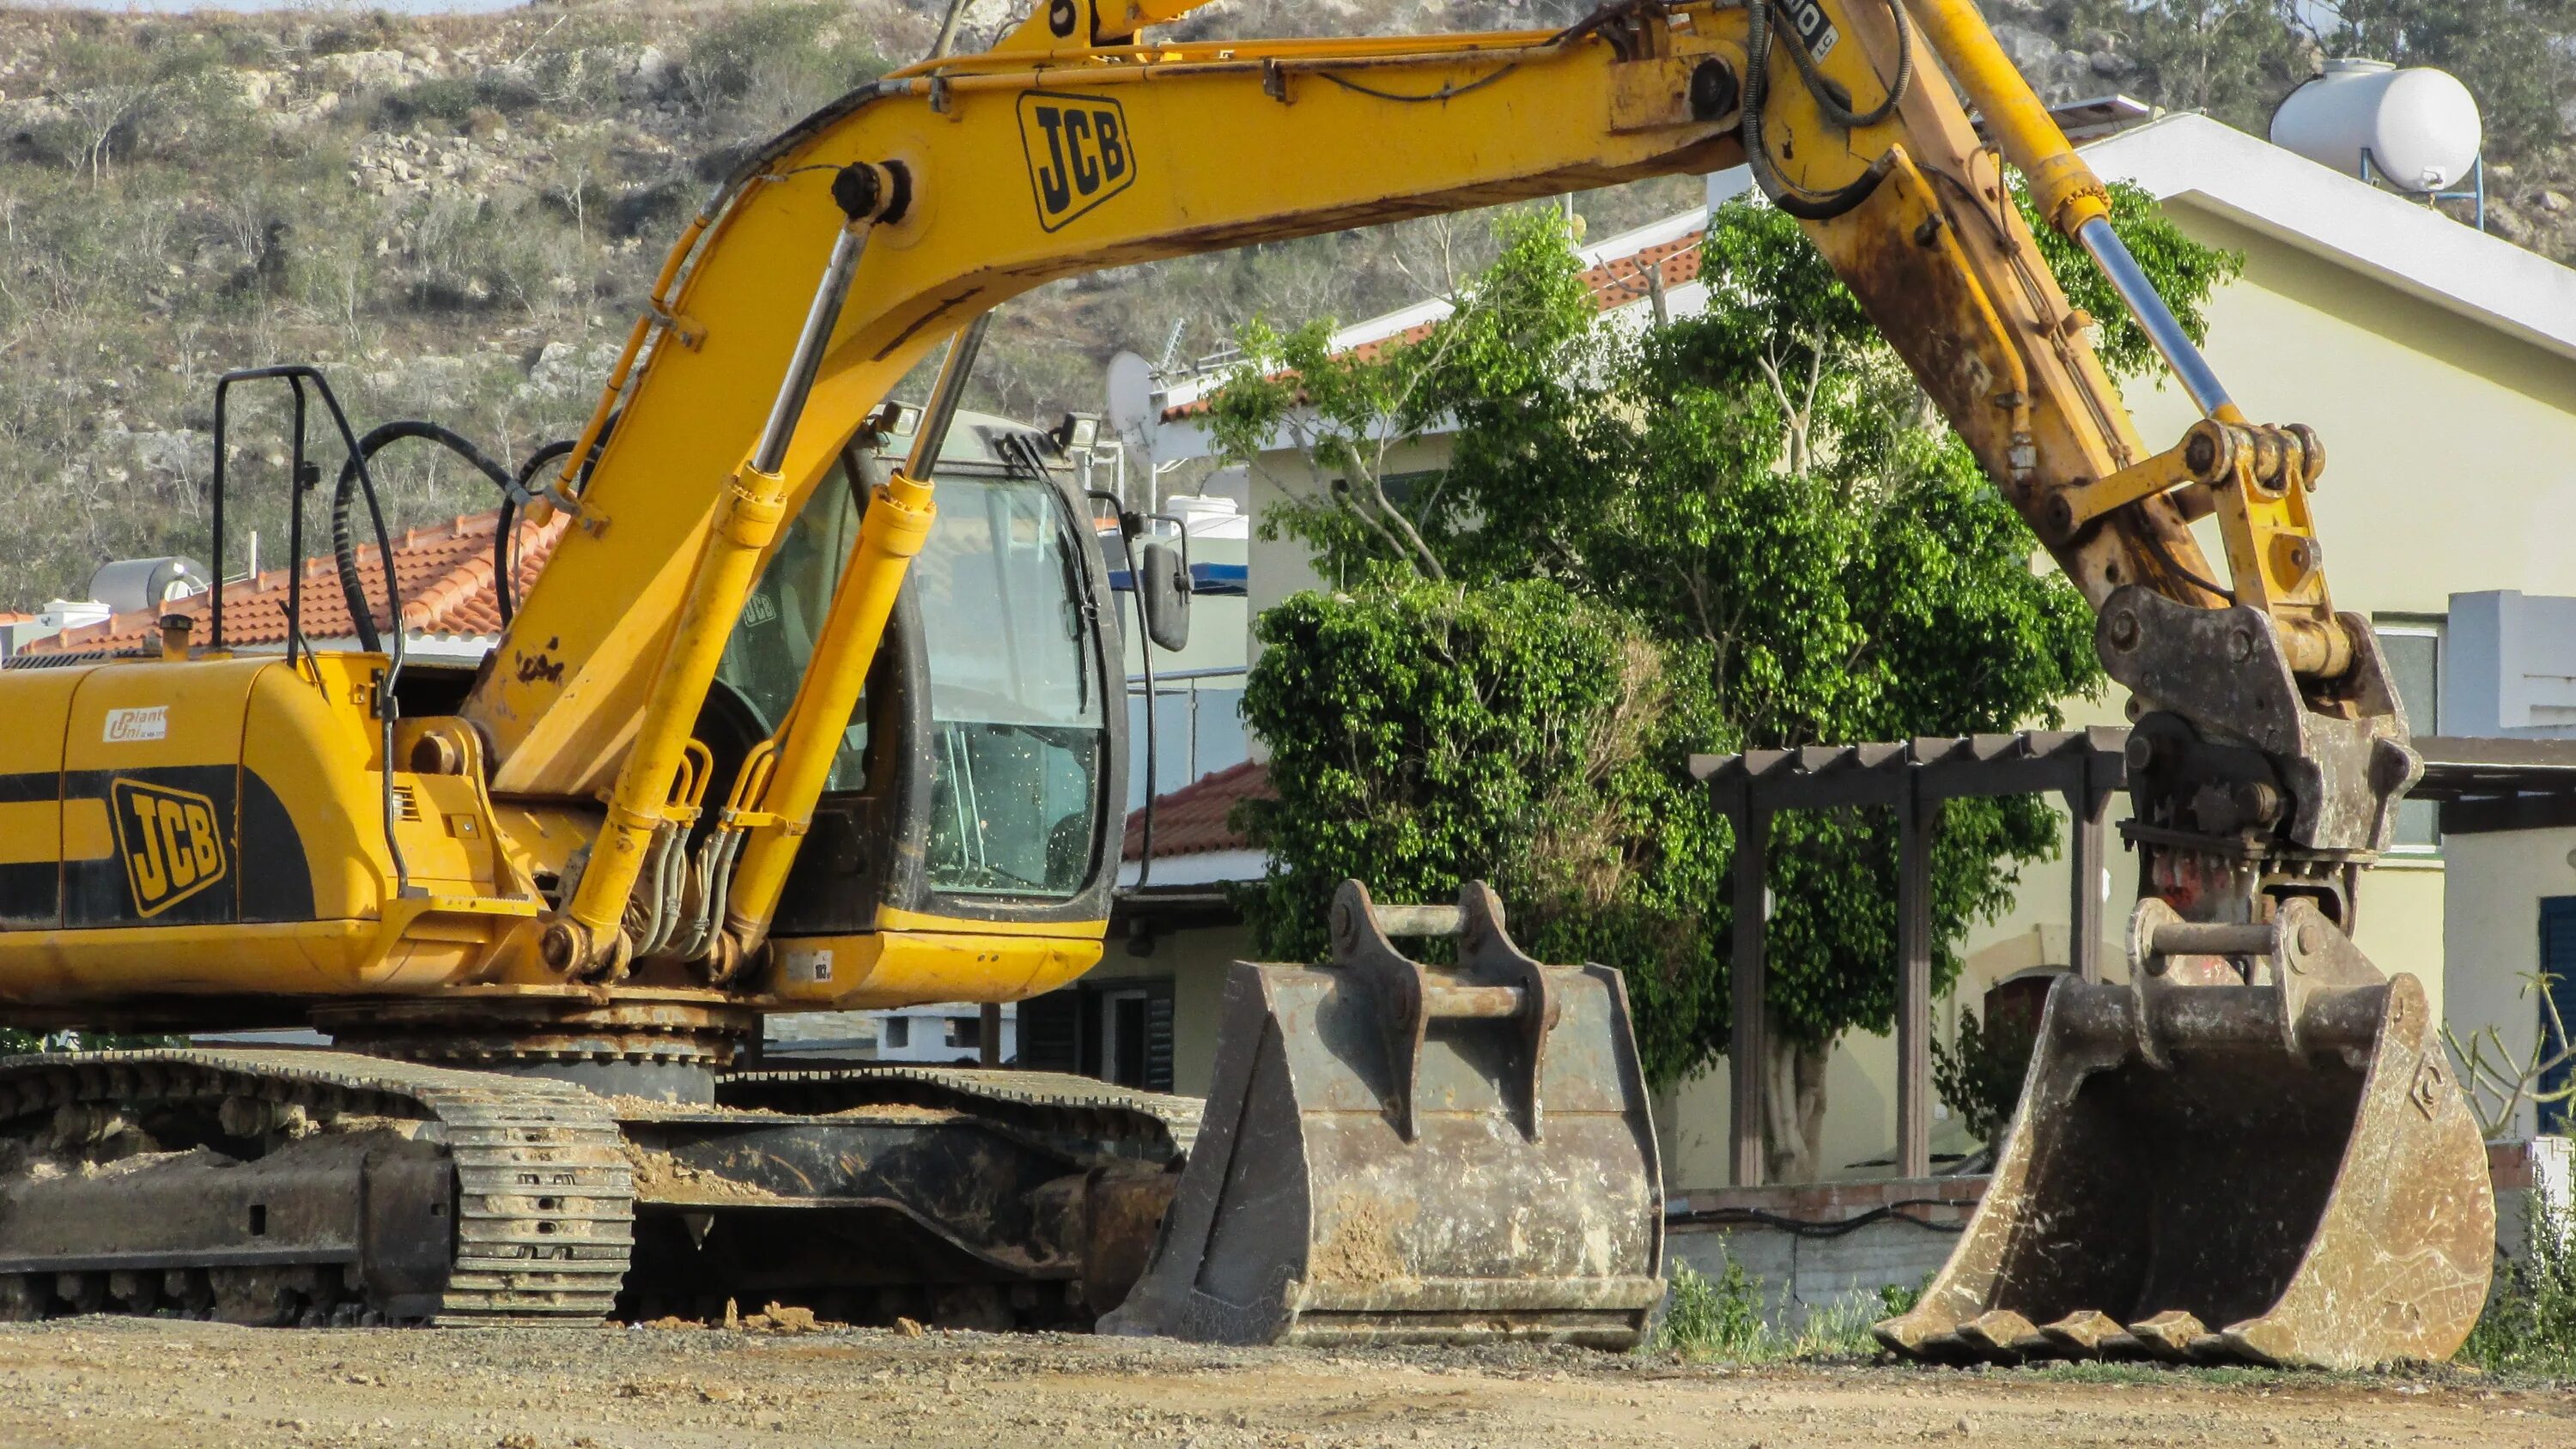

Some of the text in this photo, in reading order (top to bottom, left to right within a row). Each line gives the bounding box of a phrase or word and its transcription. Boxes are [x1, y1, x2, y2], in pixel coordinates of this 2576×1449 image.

[1817, 34, 1833, 57] LC
[1036, 106, 1125, 215] JCB
[744, 594, 774, 622] JCB
[131, 792, 217, 901] JCB
